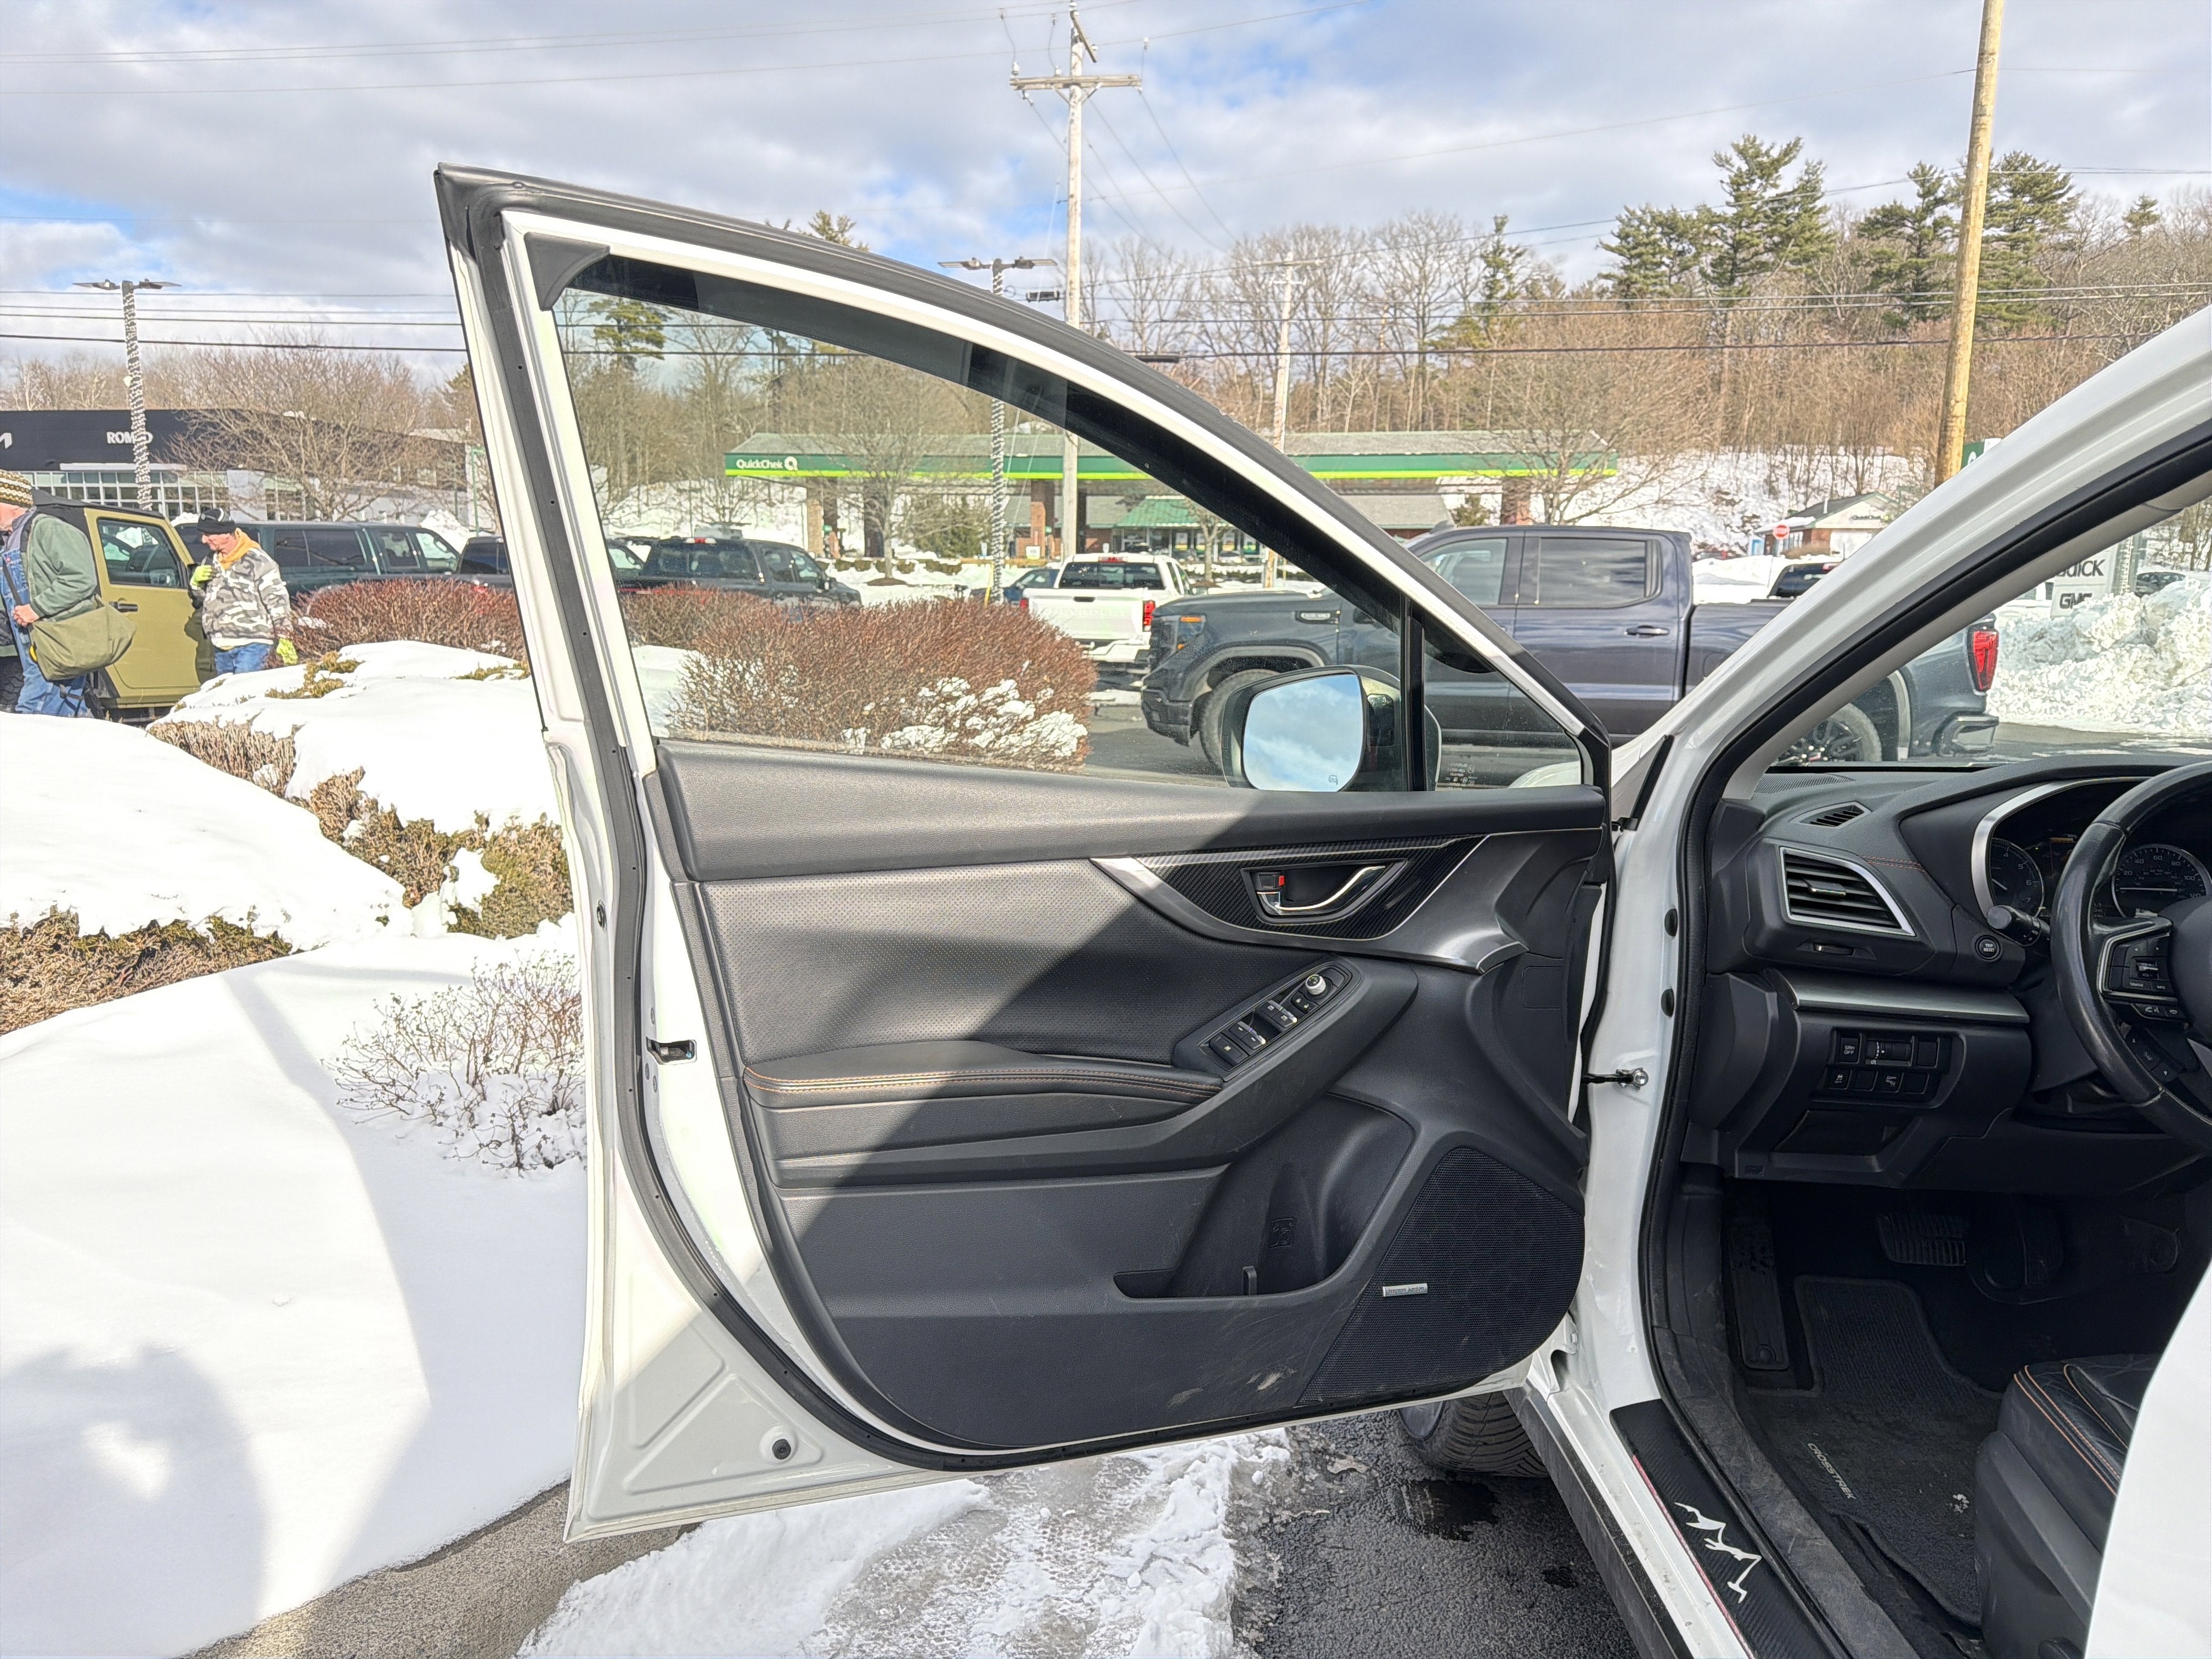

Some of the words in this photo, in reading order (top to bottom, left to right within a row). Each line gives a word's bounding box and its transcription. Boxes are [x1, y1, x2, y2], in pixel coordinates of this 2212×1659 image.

[106, 431, 153, 444] ROMO
[736, 459, 783, 469] QuickChek
[1807, 1442, 1857, 1499] CROSSTREK
